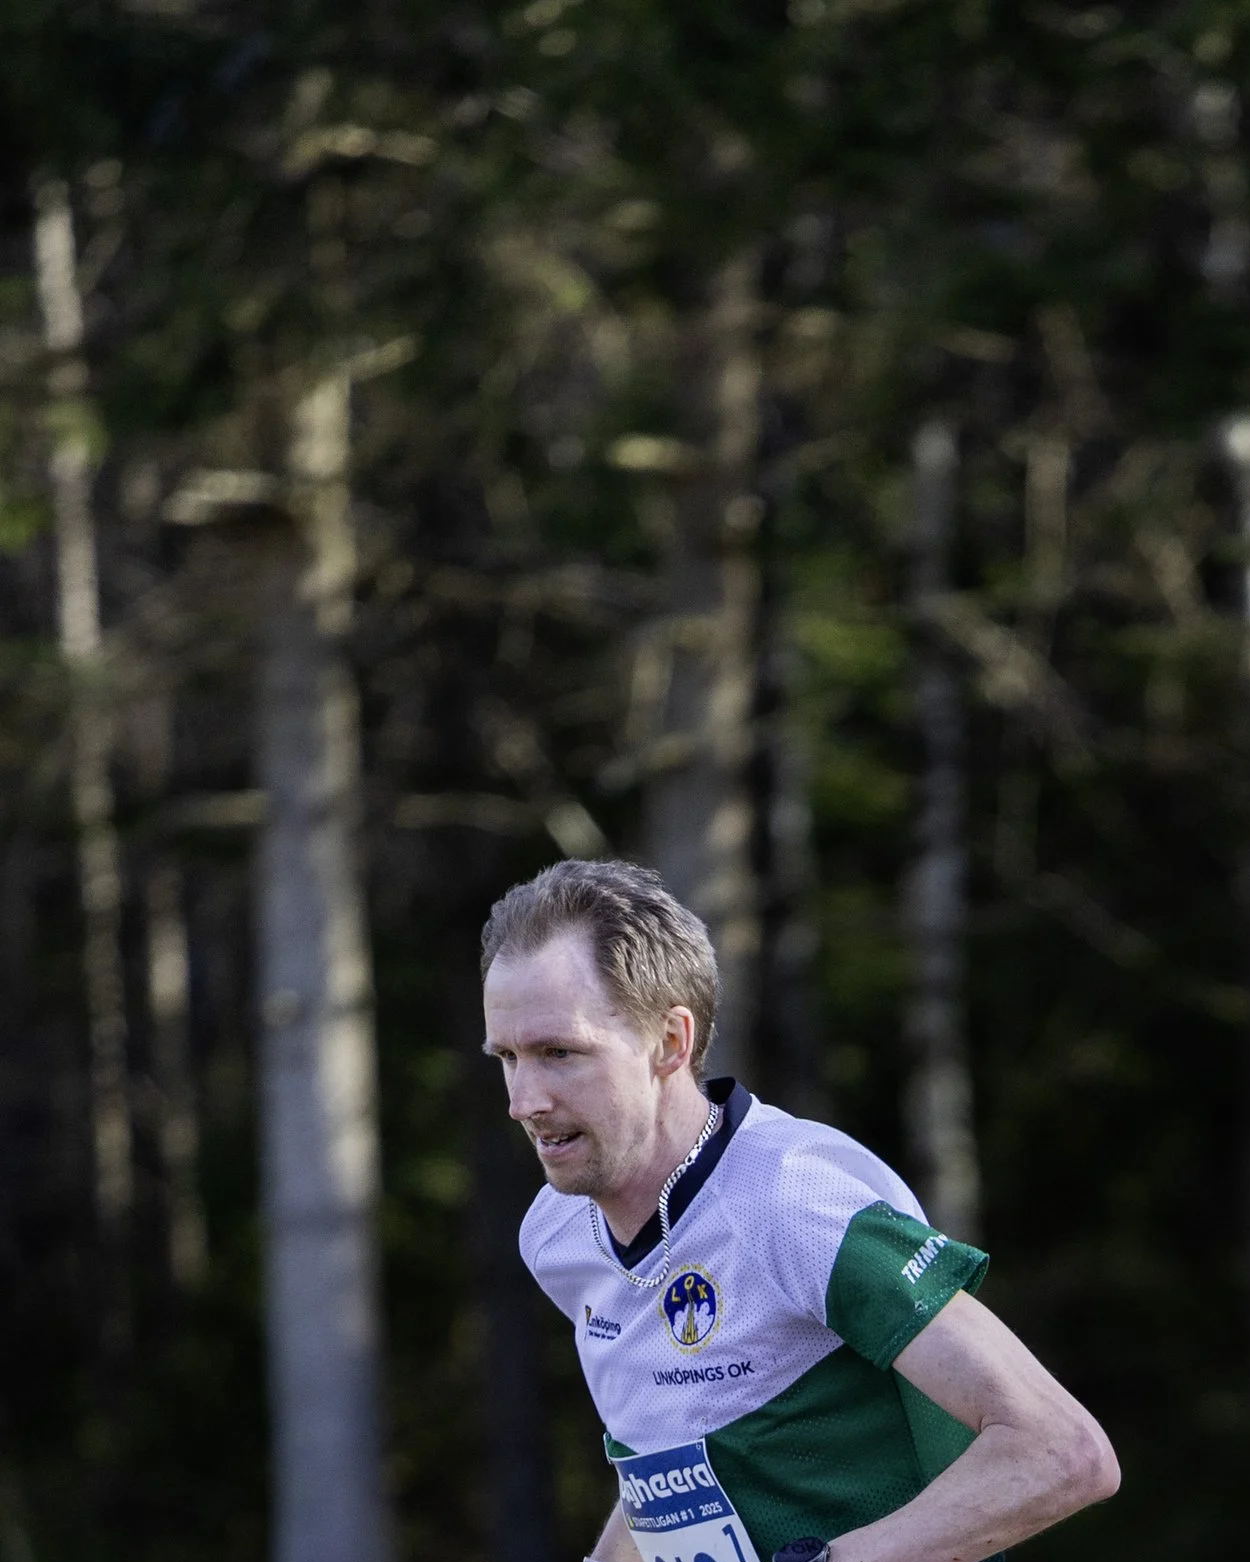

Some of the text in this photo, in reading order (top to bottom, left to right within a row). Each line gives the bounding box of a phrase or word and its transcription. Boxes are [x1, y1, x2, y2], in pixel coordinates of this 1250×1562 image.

[652, 1360, 756, 1386] LINKÖPINGS OK
[699, 1501, 723, 1517] 2025
